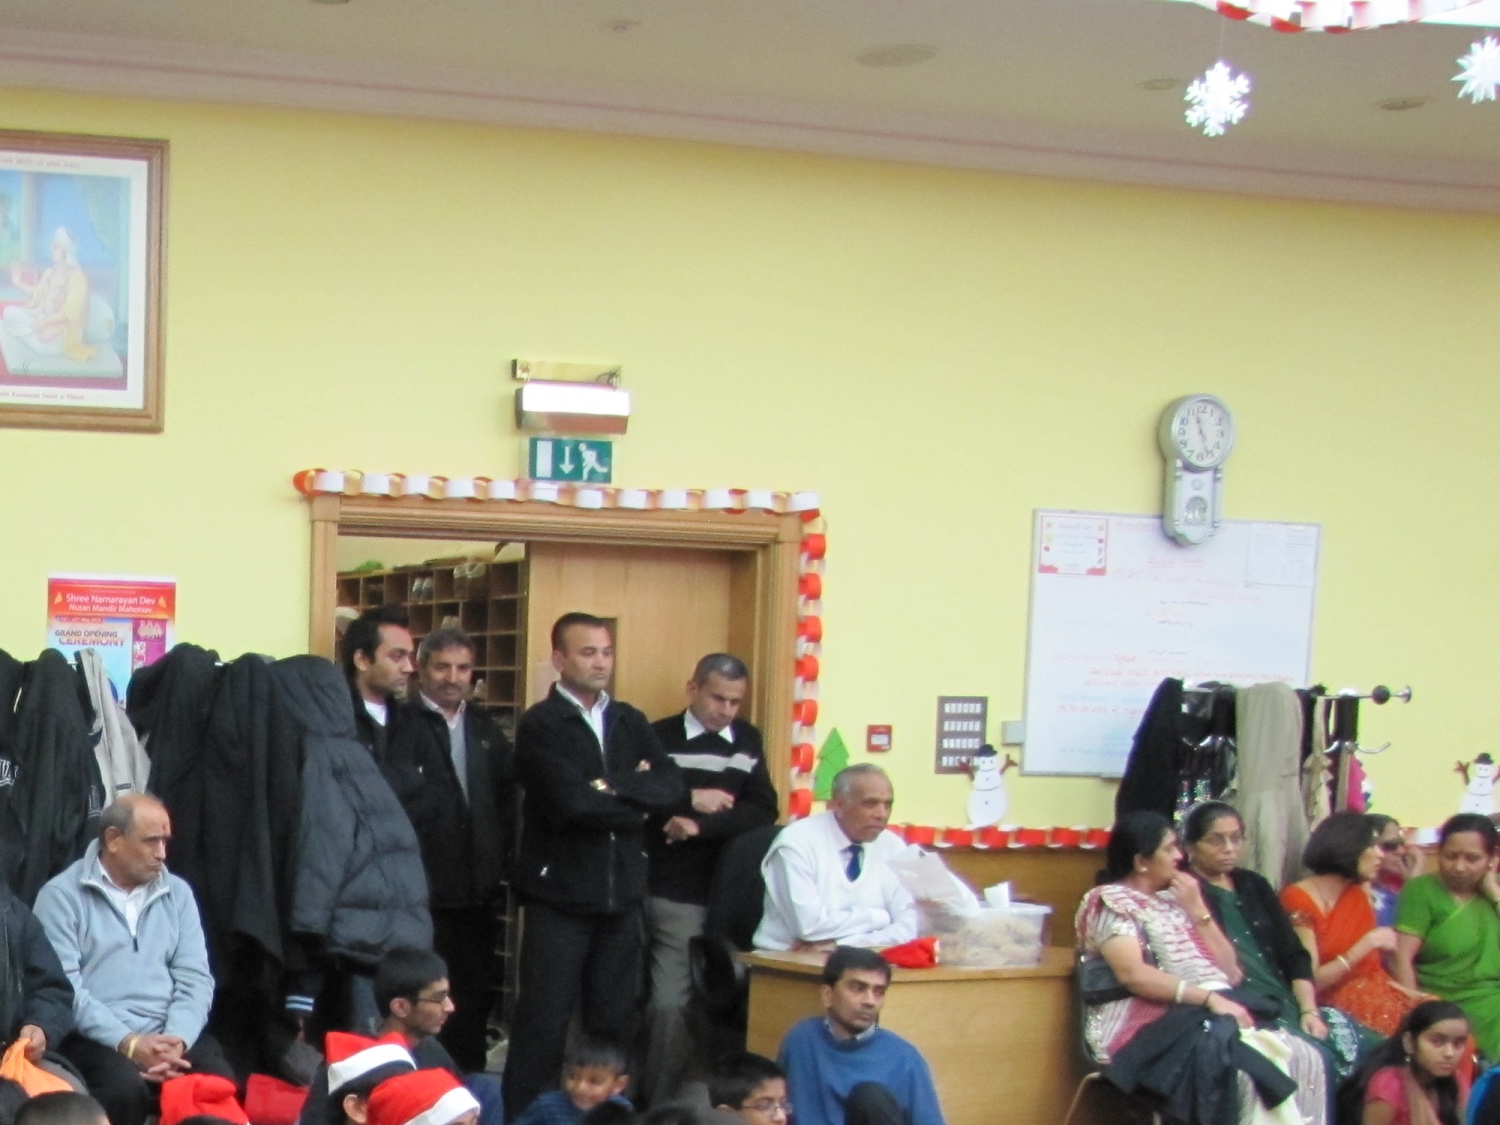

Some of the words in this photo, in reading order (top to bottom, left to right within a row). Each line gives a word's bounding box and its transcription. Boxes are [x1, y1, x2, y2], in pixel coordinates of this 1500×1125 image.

[66, 594, 90, 603] Shree
[91, 595, 138, 607] Narnarayan
[140, 596, 156, 605] Dev
[92, 604, 117, 612] Mandir
[118, 605, 153, 613] Mahotsav
[54, 629, 83, 637] GRAND
[84, 630, 118, 638] OPENING
[58, 638, 125, 647] CEREMONY
